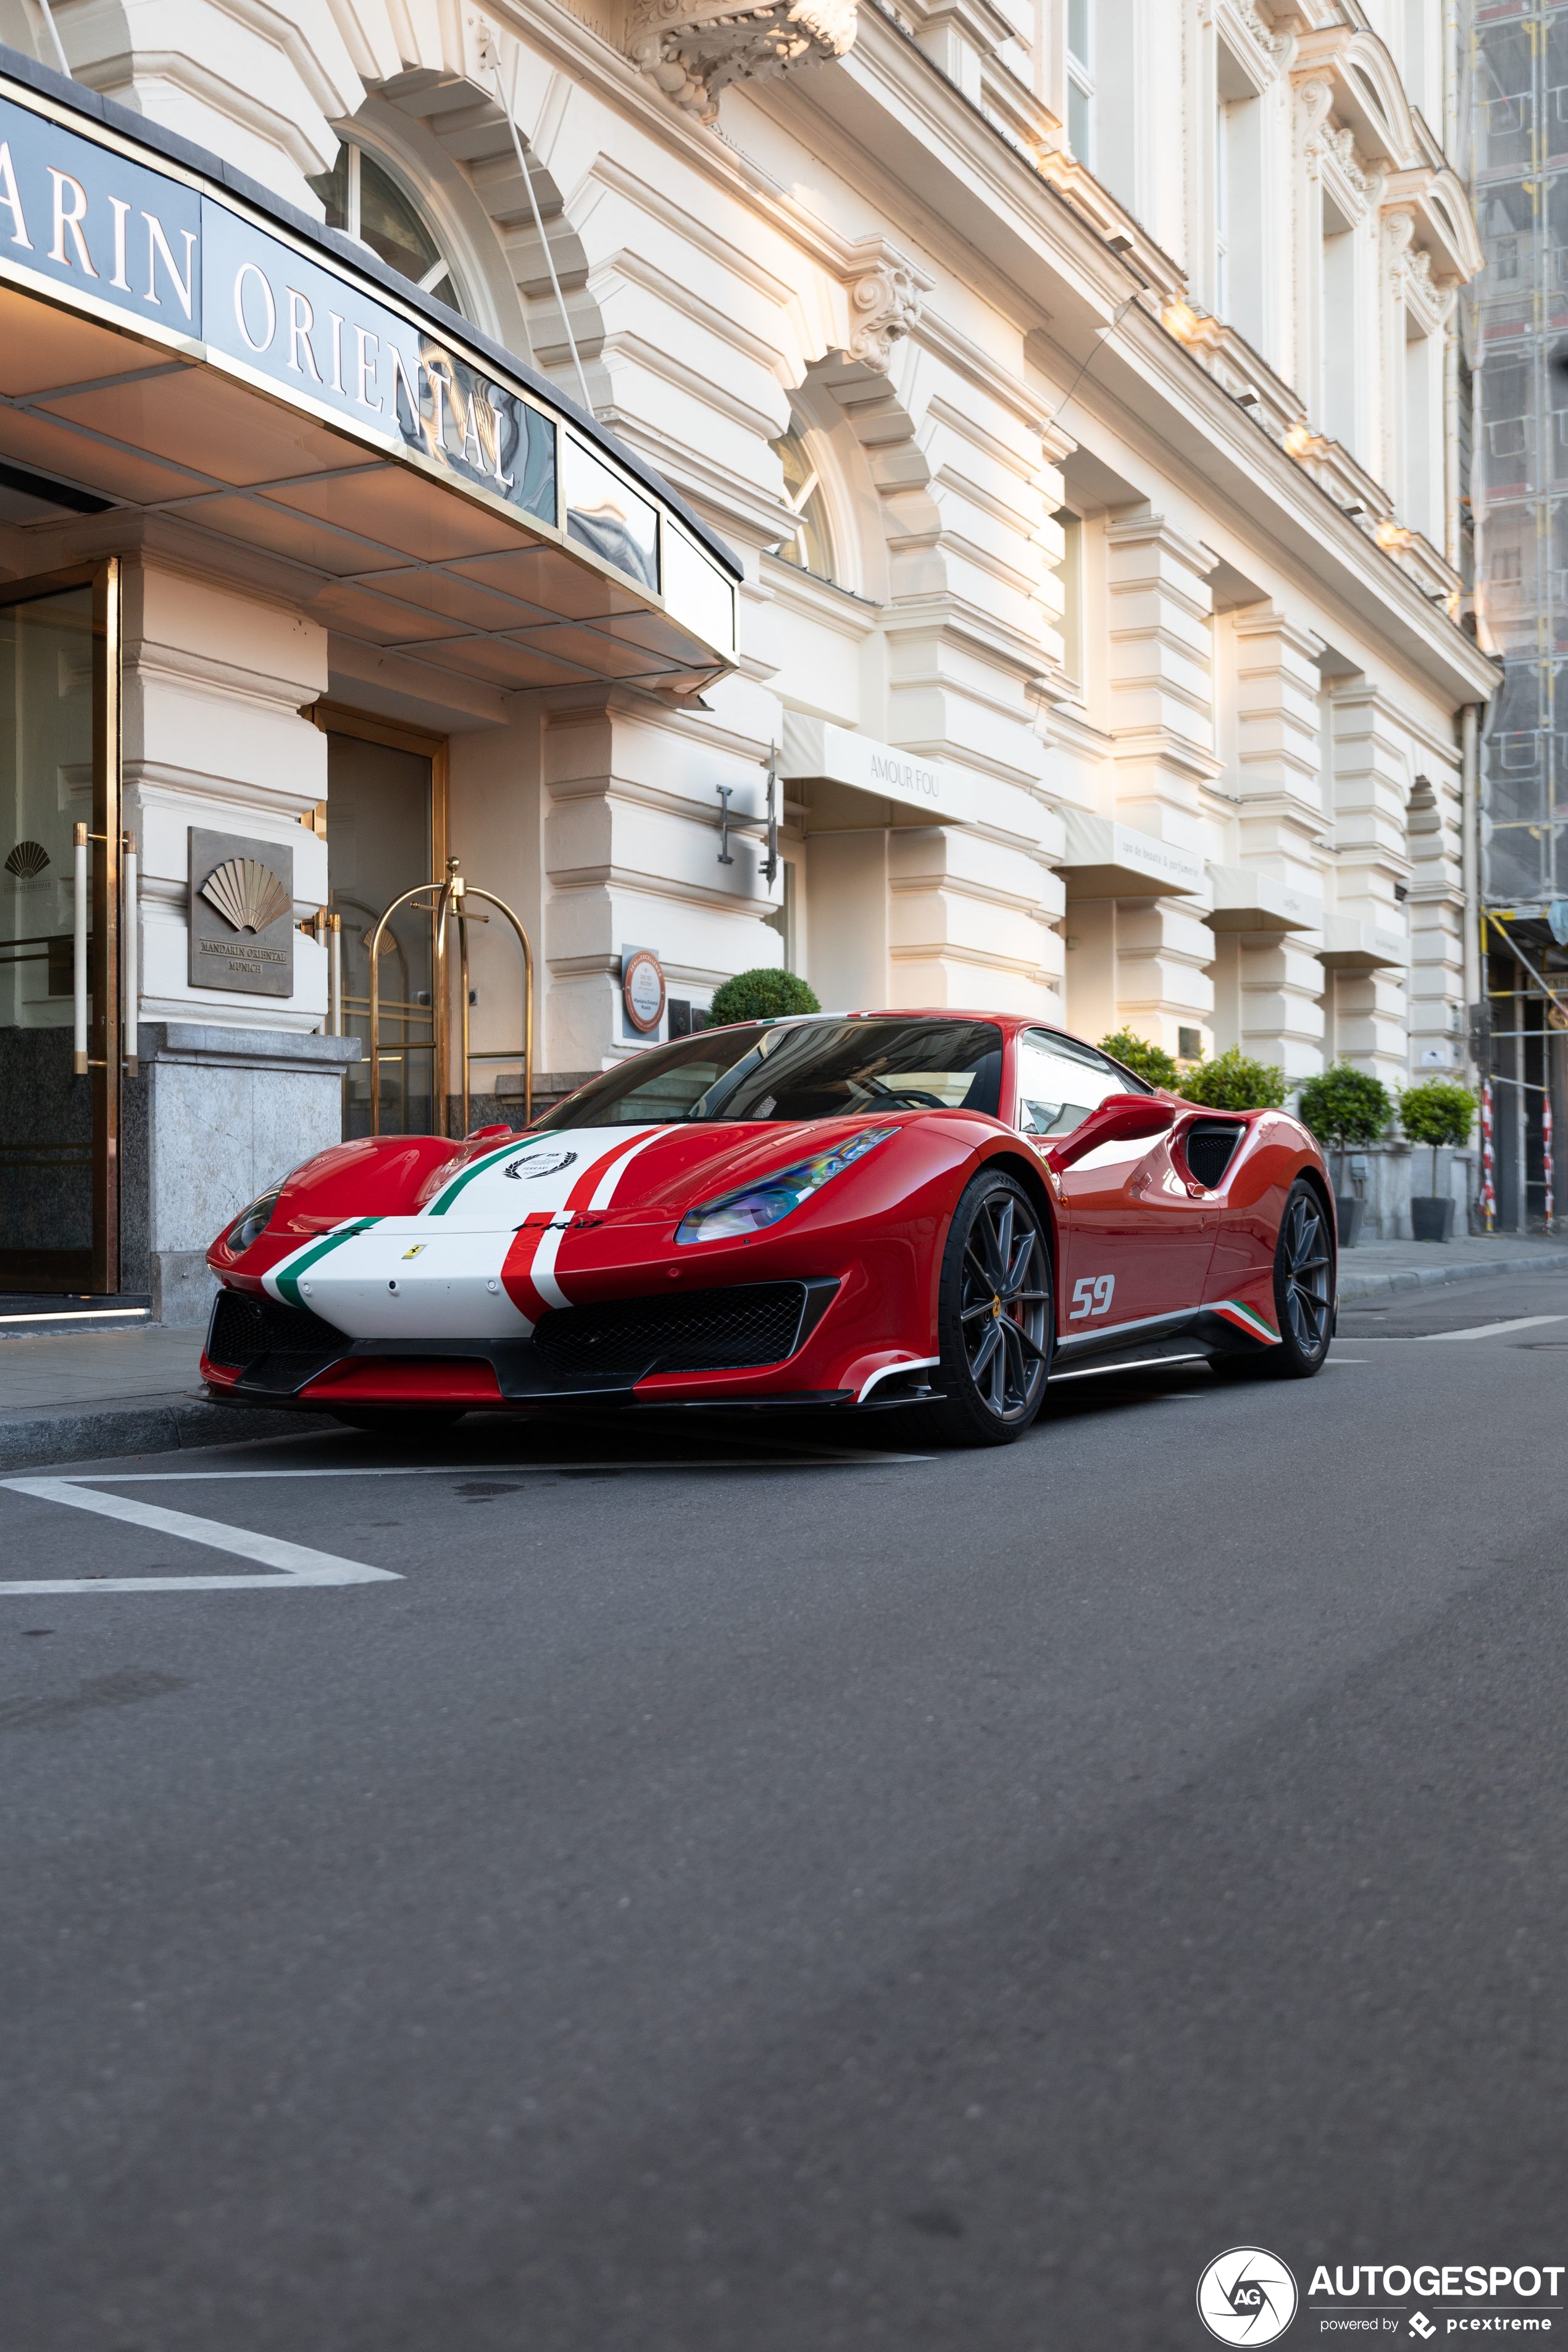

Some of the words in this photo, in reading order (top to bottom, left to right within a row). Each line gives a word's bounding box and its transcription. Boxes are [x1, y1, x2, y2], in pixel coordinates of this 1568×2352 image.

[234, 262, 515, 487] ORIENTAL
[871, 754, 913, 789] AMOUR
[916, 770, 939, 797] FOU
[1123, 843, 1133, 854] spa
[1135, 844, 1141, 857] de
[1169, 861, 1199, 878] parfumerie
[201, 942, 245, 957] MANDARIN
[247, 948, 286, 962] ORIENTAL
[228, 961, 262, 974] MUNICH
[1069, 1274, 1115, 1320] 59
